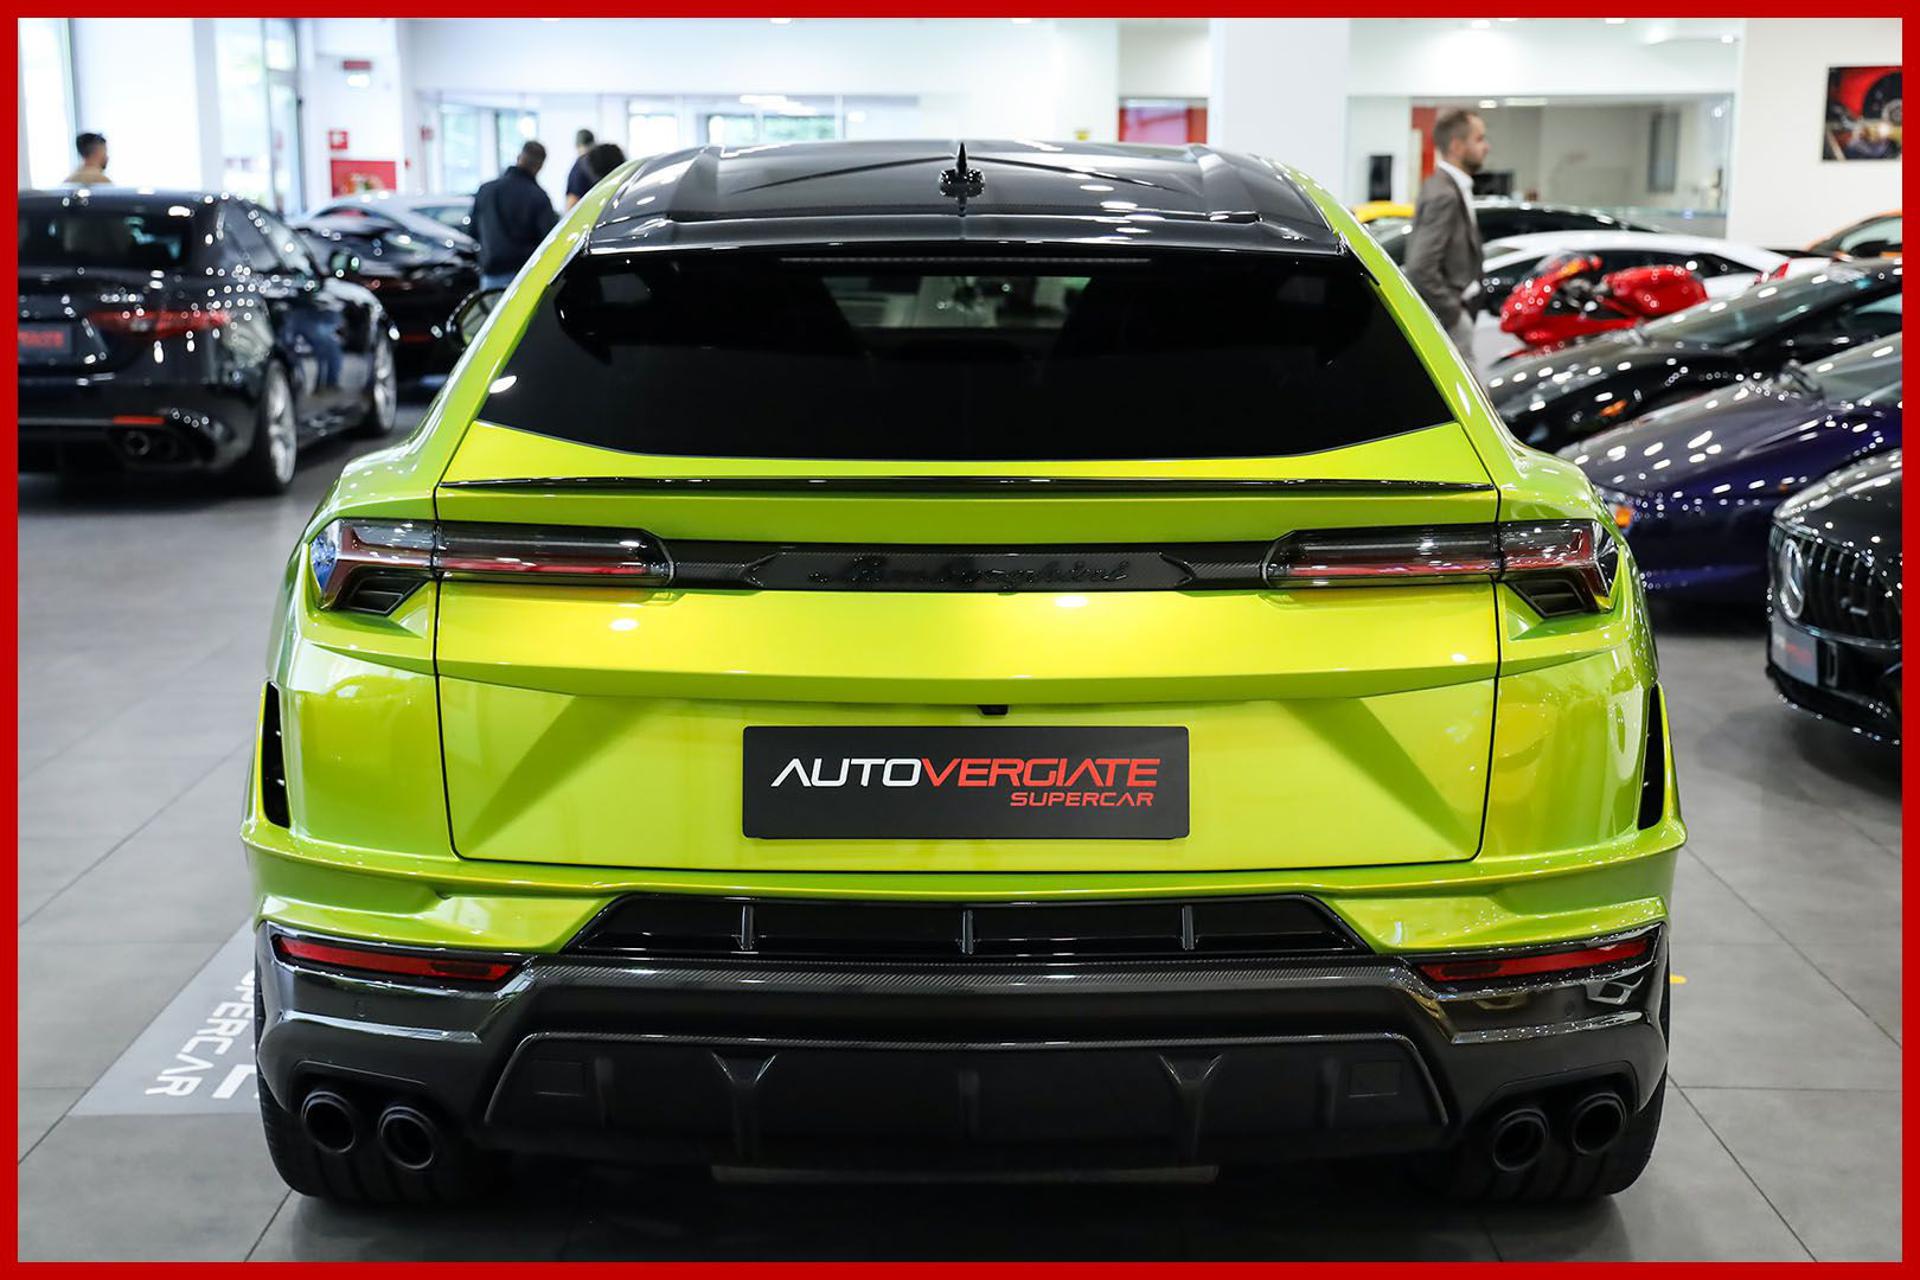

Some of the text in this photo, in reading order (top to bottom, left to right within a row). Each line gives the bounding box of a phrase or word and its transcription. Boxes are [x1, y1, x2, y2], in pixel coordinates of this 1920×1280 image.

[771, 757, 1161, 787] AUTOVERGIATE
[1010, 791, 1154, 807] SUPERCAR
[145, 969, 256, 1097] PERCAR
